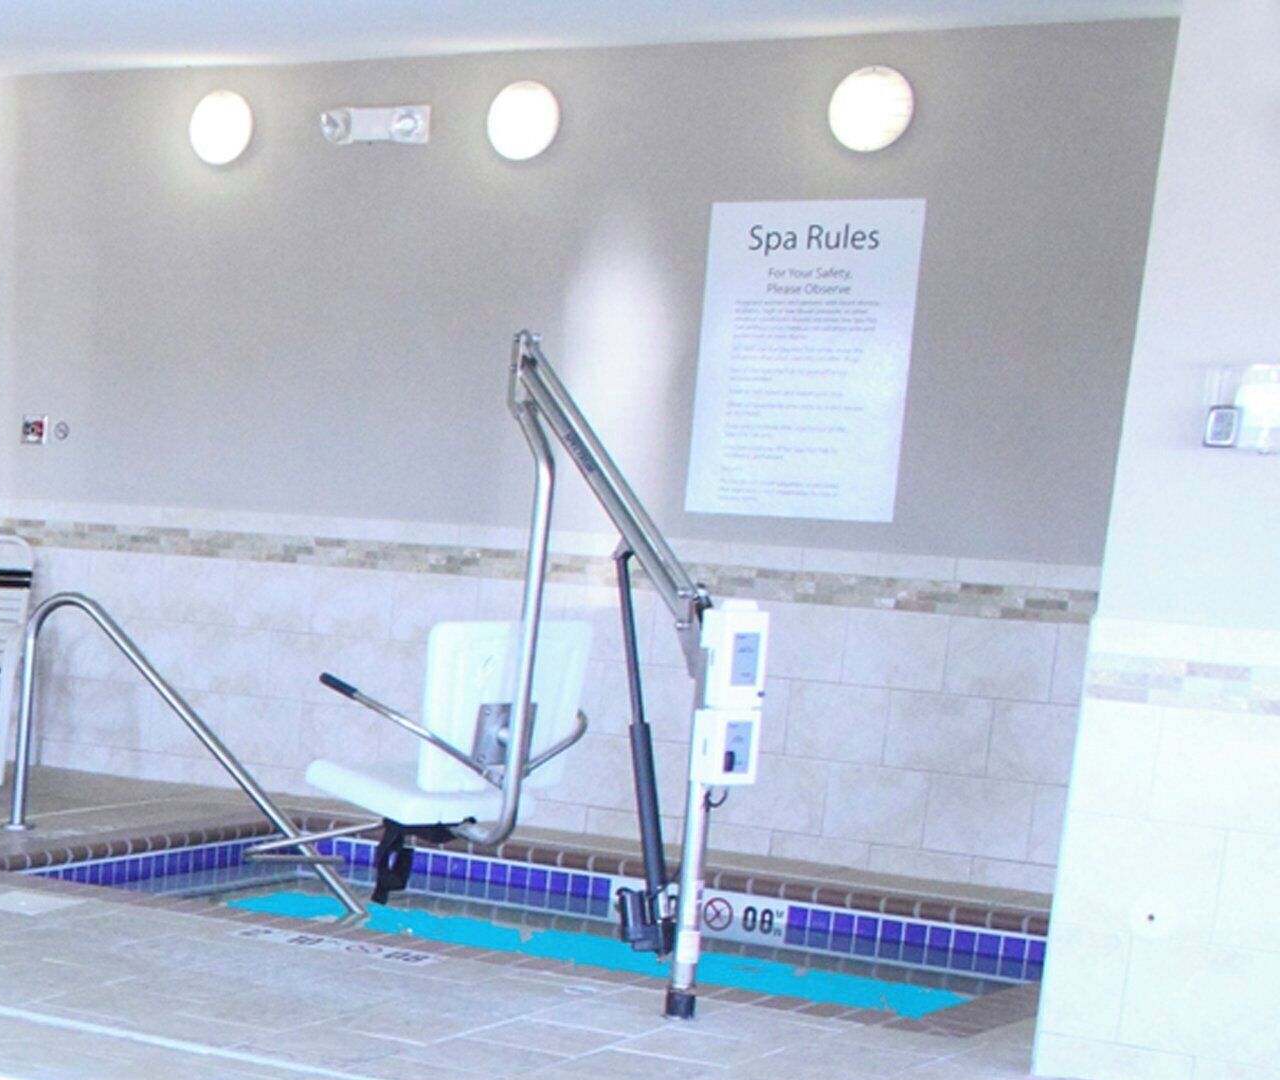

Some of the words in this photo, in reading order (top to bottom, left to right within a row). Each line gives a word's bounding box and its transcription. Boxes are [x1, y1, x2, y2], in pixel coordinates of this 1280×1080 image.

[748, 224, 797, 256] Spa
[806, 223, 880, 250] Rules
[768, 267, 786, 279] For
[788, 267, 813, 279] Your
[766, 283, 800, 295] Please
[804, 283, 851, 296] Observe
